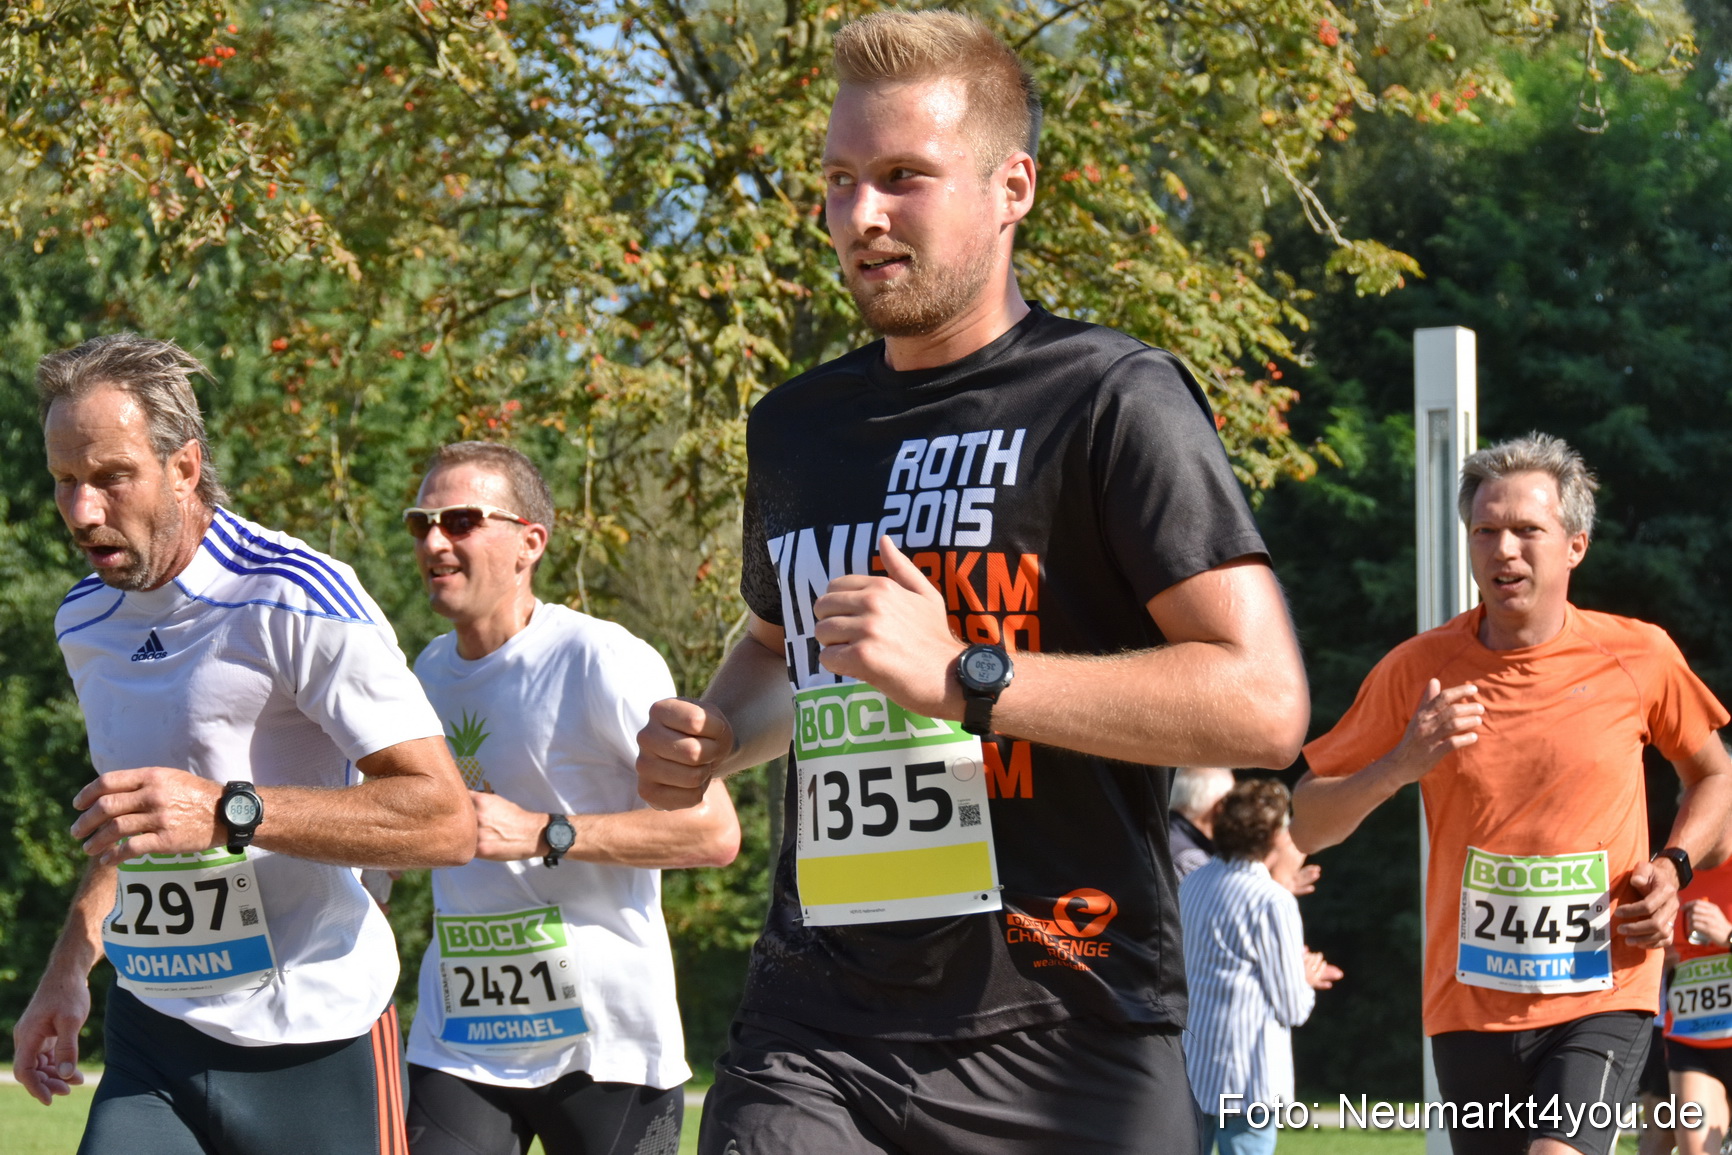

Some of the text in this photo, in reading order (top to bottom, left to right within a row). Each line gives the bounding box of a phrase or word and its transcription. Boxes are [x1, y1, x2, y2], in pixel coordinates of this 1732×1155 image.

[887, 428, 1026, 492] ROTH
[875, 487, 996, 550] 2015
[131, 651, 168, 662] adidas
[800, 690, 955, 752] BOCK
[807, 760, 954, 842] 1355
[236, 877, 247, 888] C
[1470, 856, 1598, 892] BOCK
[443, 913, 556, 953] BOCK
[1474, 899, 1593, 945] 2445
[1007, 928, 1112, 958] CHALENGE
[125, 949, 233, 977] JOHANN
[1486, 954, 1576, 978] MARTIN
[454, 961, 557, 1008] 2421
[1673, 983, 1732, 1014] 2785
[467, 1018, 564, 1041] MICHAEL
